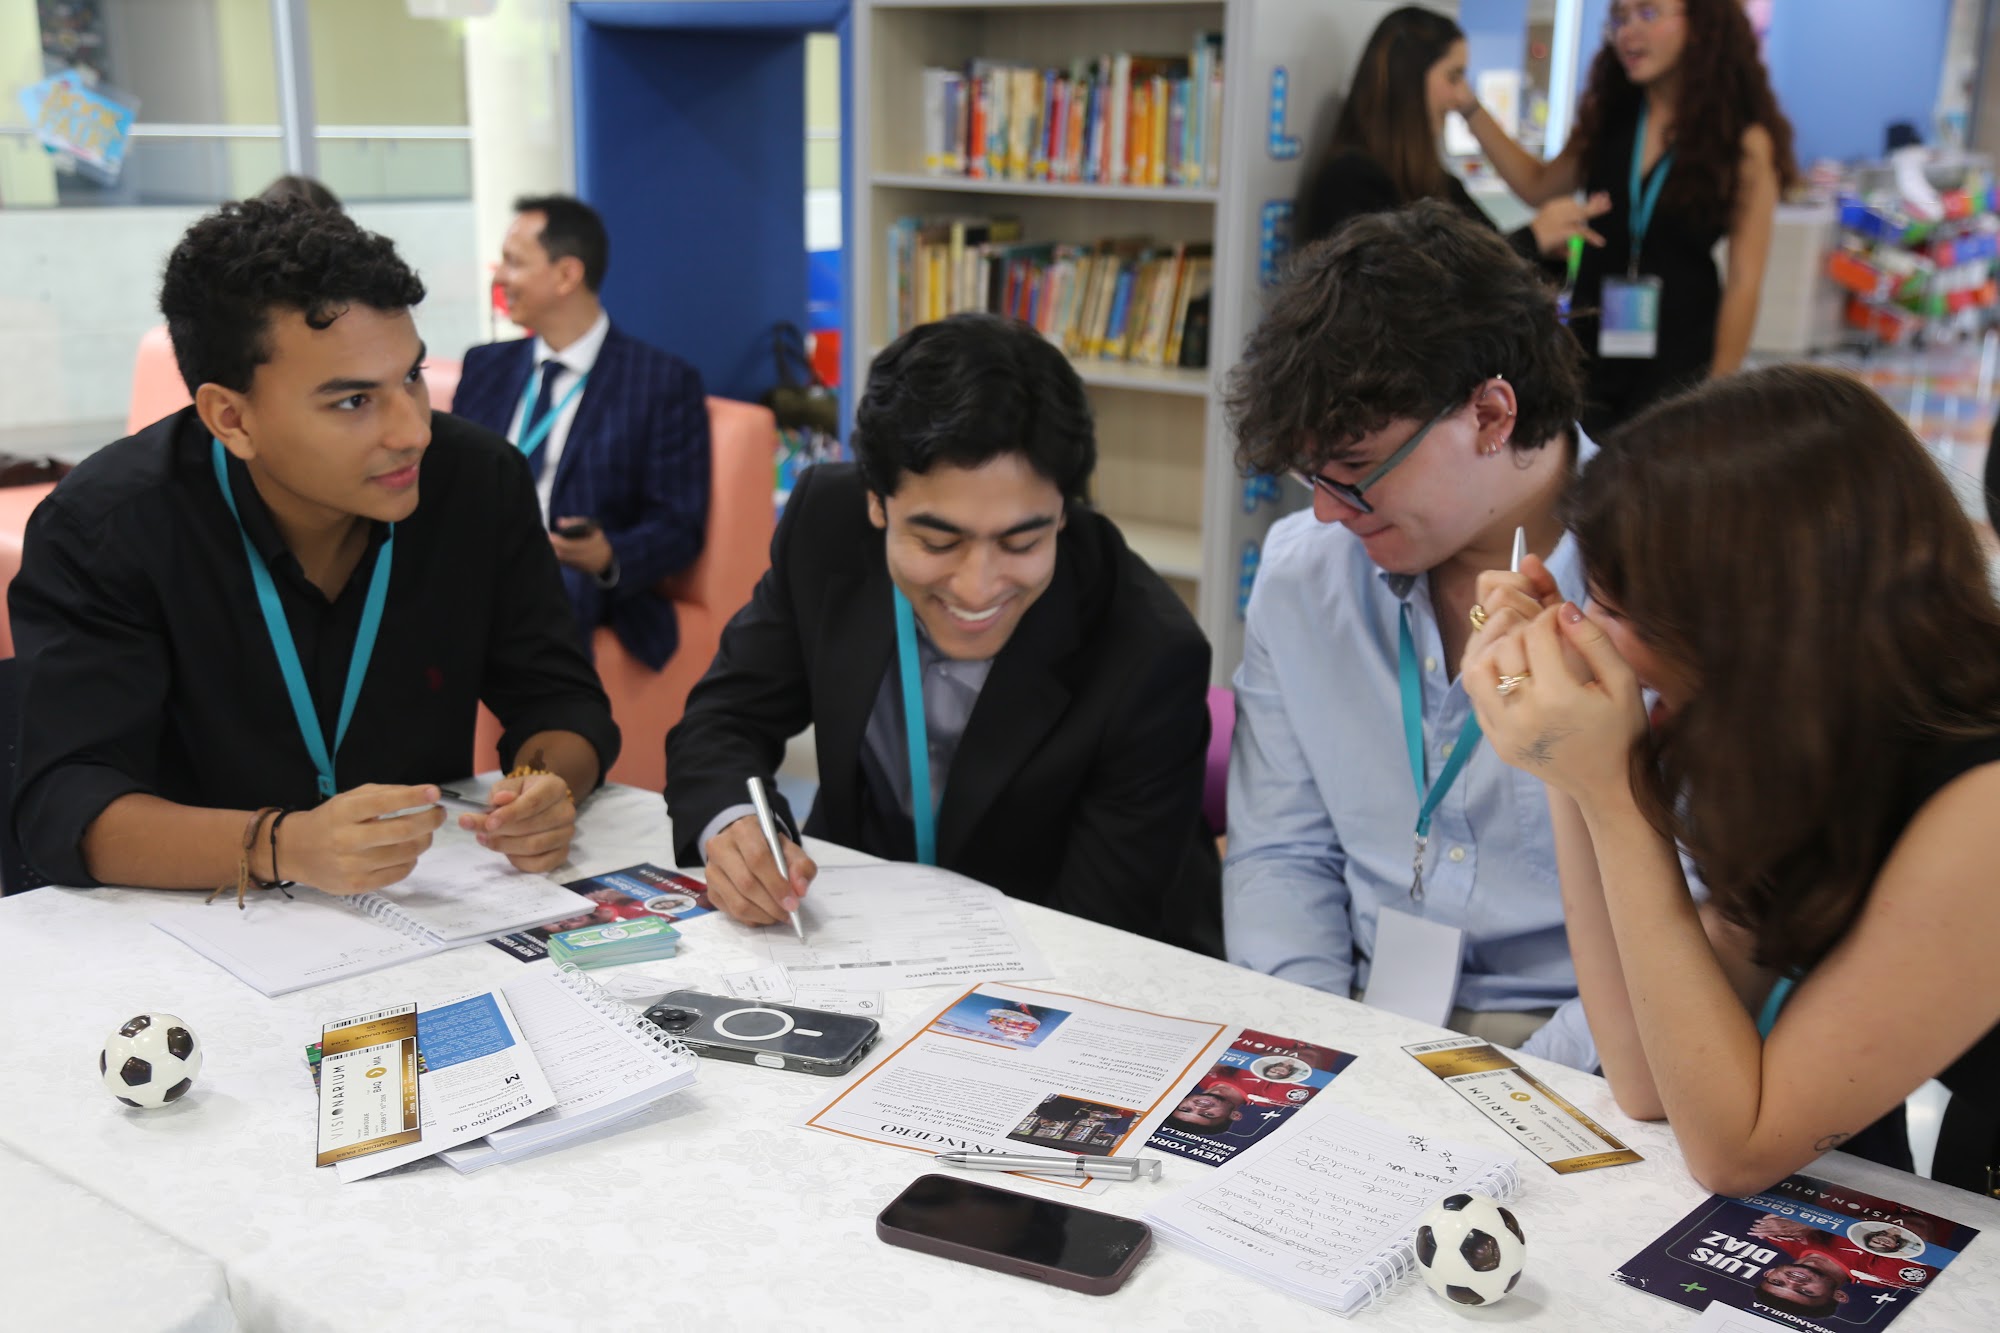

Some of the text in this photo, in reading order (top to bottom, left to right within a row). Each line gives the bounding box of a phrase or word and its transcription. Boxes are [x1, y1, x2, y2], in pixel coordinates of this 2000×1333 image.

[511, 944, 539, 958] NEW
[973, 965, 1024, 974] Formato
[381, 1025, 408, 1035] JULIAN
[372, 1055, 382, 1093] BAQ MIA
[331, 1065, 345, 1140] VISIONARIUM
[477, 1102, 514, 1118] sueño
[520, 1099, 532, 1107] El
[1528, 1103, 1547, 1116] BAQ
[471, 1106, 516, 1126] tamaño
[1468, 1087, 1553, 1150] VISIONARIUM
[336, 1139, 398, 1157] BOARDING PASS
[1146, 1134, 1225, 1162] NEW YORK
[1162, 1127, 1237, 1152] BARRANQUILLA
[1198, 1142, 1230, 1158] MEETS
[1586, 1156, 1622, 1166] BOARDING
[1330, 1205, 1352, 1215] nos
[1781, 1183, 1904, 1226] VISIONARIU
[1797, 1206, 1834, 1220] tamaño
[1800, 1212, 1839, 1230] Lala
[1207, 1226, 1274, 1256] VISIONARIUM
[1700, 1231, 1778, 1264] DÍAZ
[1691, 1248, 1761, 1279] LUIS
